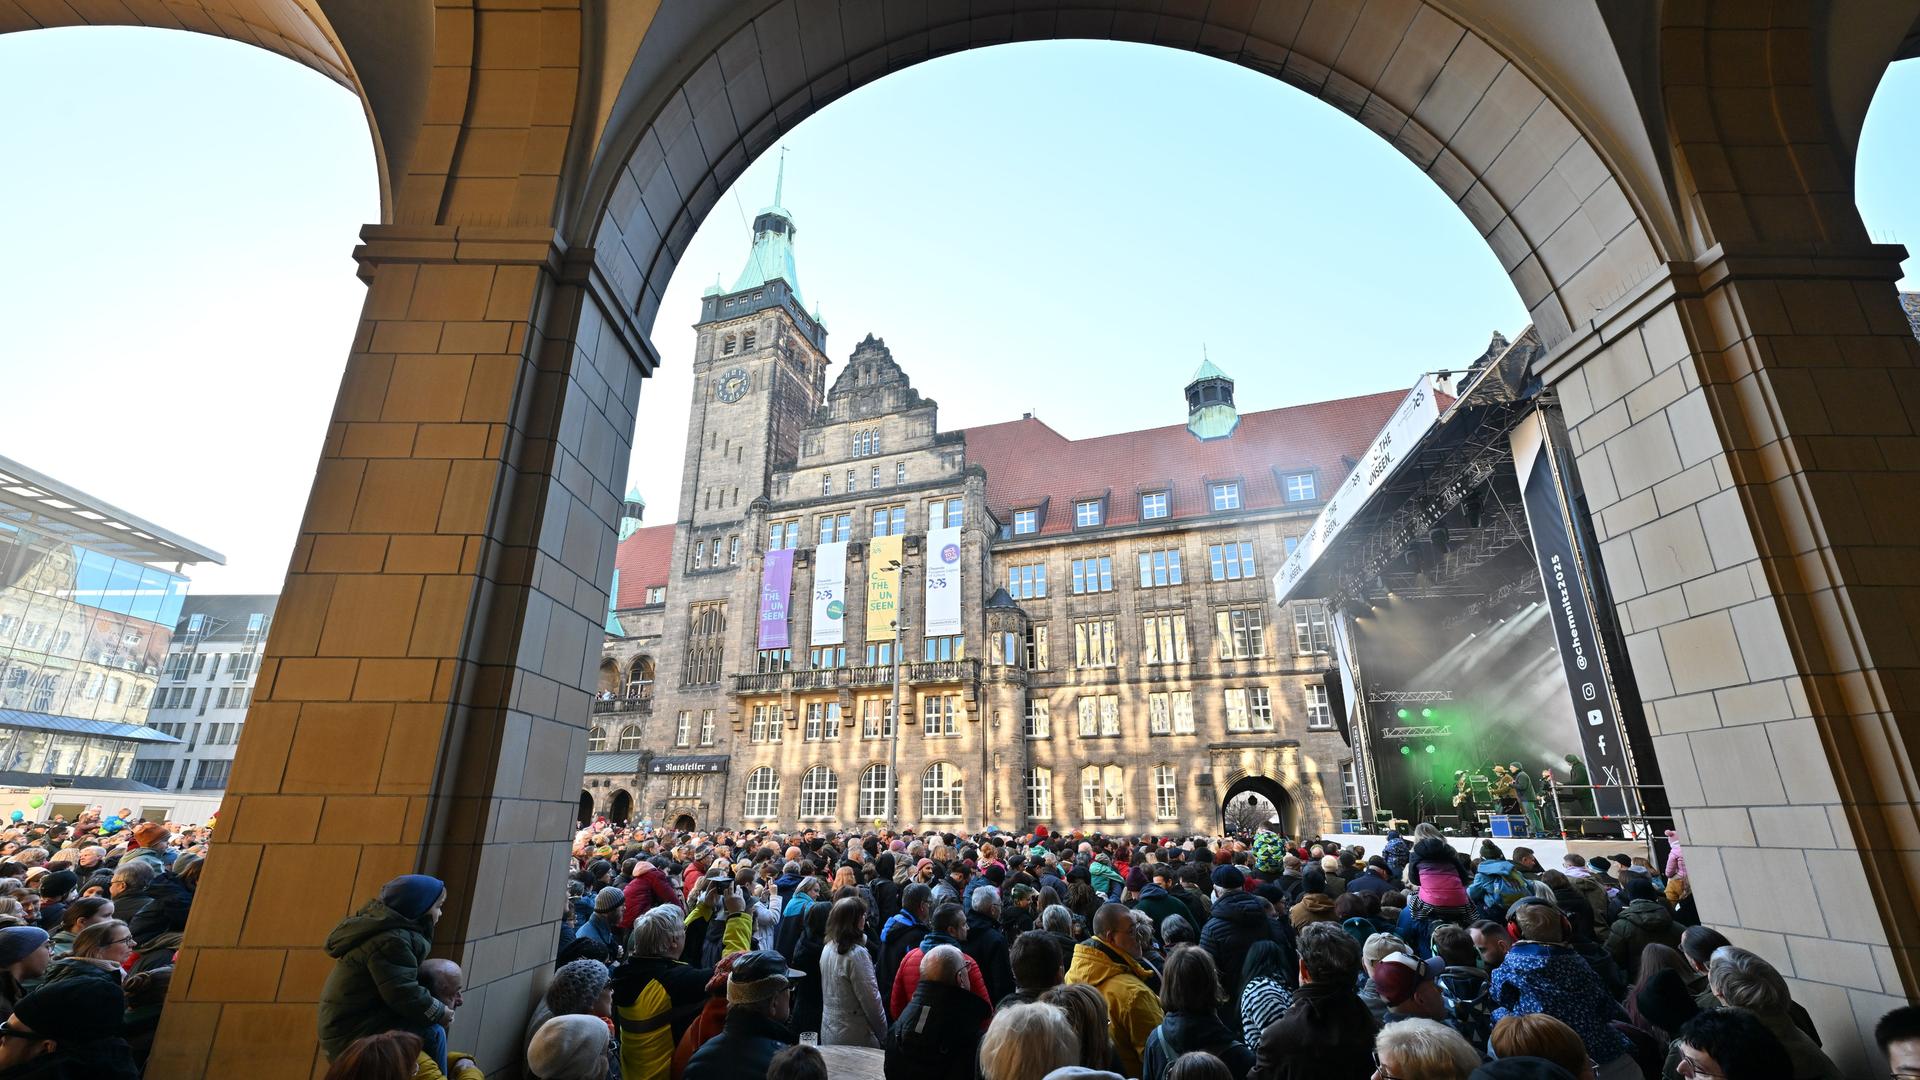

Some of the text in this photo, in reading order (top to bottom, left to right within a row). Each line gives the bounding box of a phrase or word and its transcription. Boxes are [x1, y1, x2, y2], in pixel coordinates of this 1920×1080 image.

[1379, 432, 1392, 453] THE
[872, 582, 888, 590] THE
[765, 592, 780, 601] THE
[1551, 554, 1588, 670] @chemnitz2025
